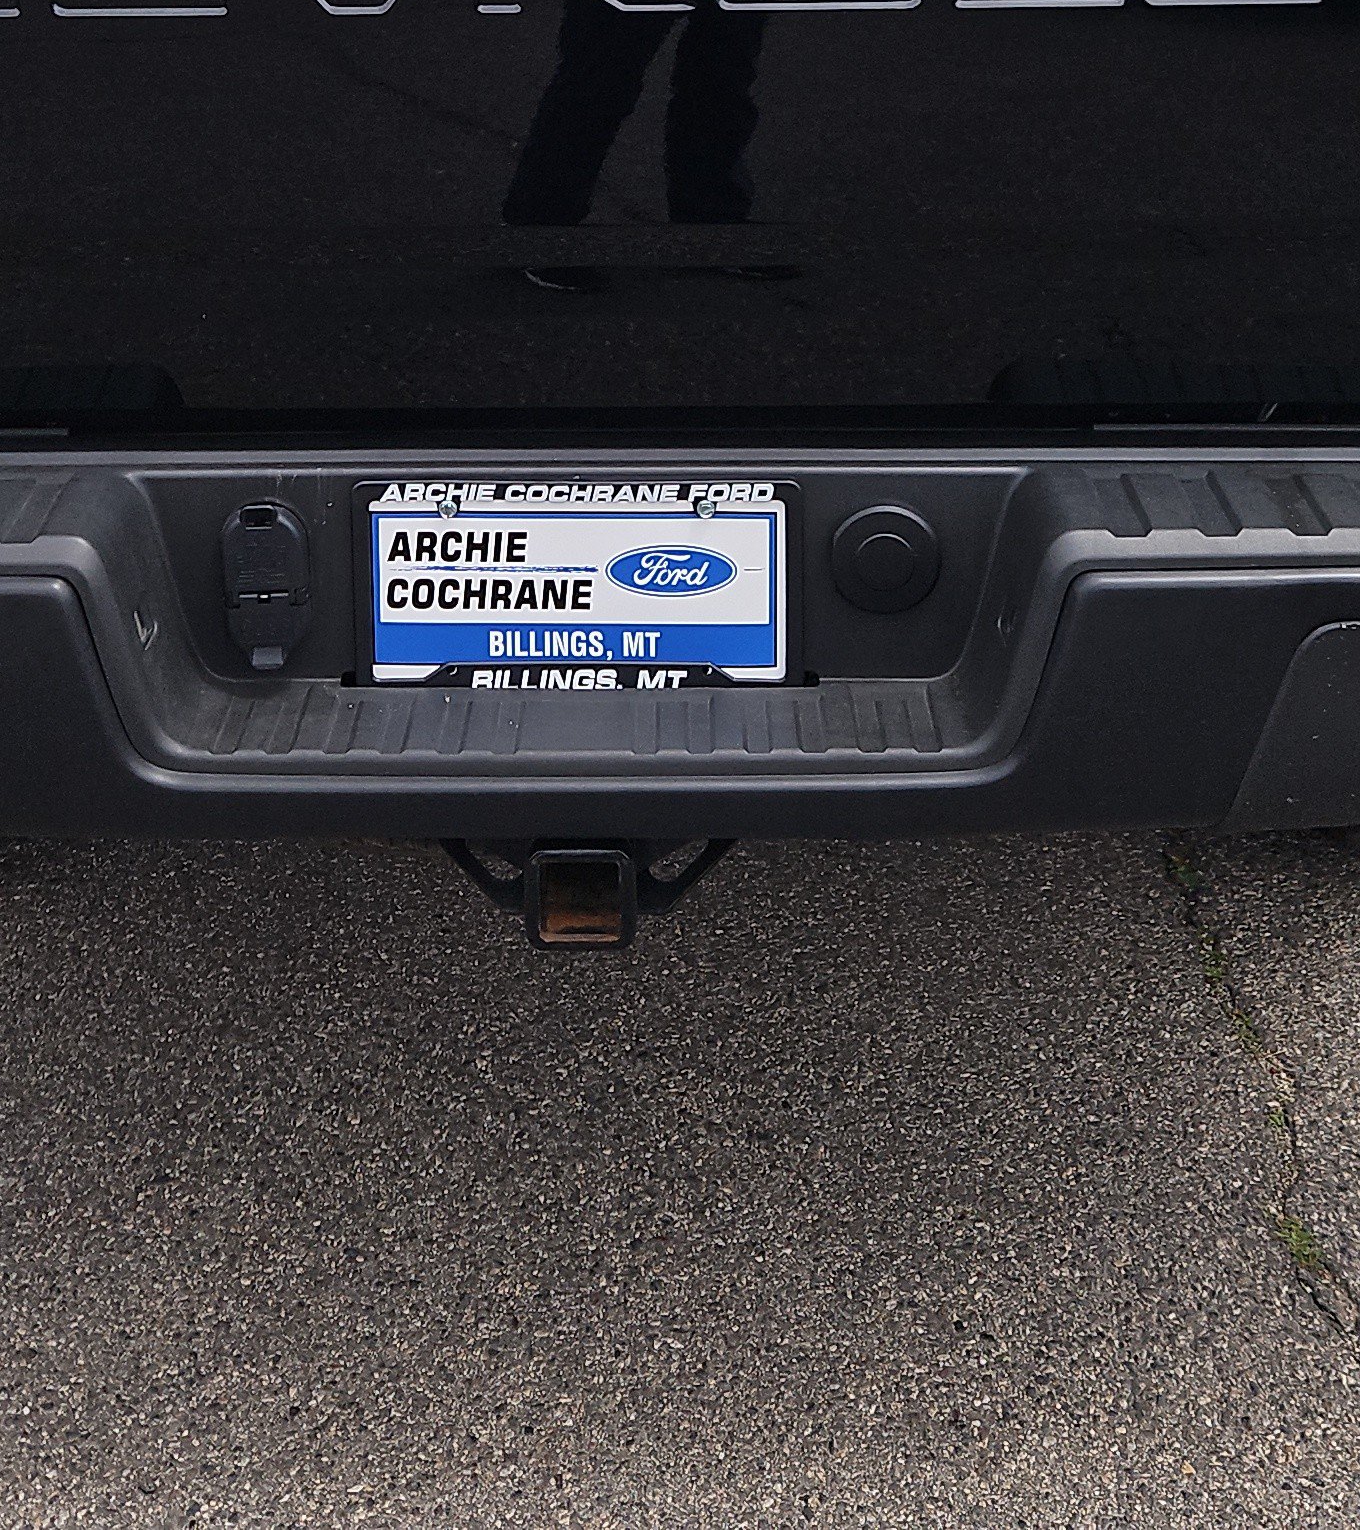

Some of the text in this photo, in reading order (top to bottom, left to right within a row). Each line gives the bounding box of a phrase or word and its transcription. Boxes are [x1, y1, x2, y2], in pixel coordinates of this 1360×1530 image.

[380, 483, 774, 503] ARCHIE COCHRANE FORD
[387, 531, 528, 562] ARCHIE
[633, 552, 711, 586] Ford
[387, 578, 593, 610] COCHRANE
[489, 630, 661, 661] BILLINGS, MT
[636, 670, 688, 689] MT
